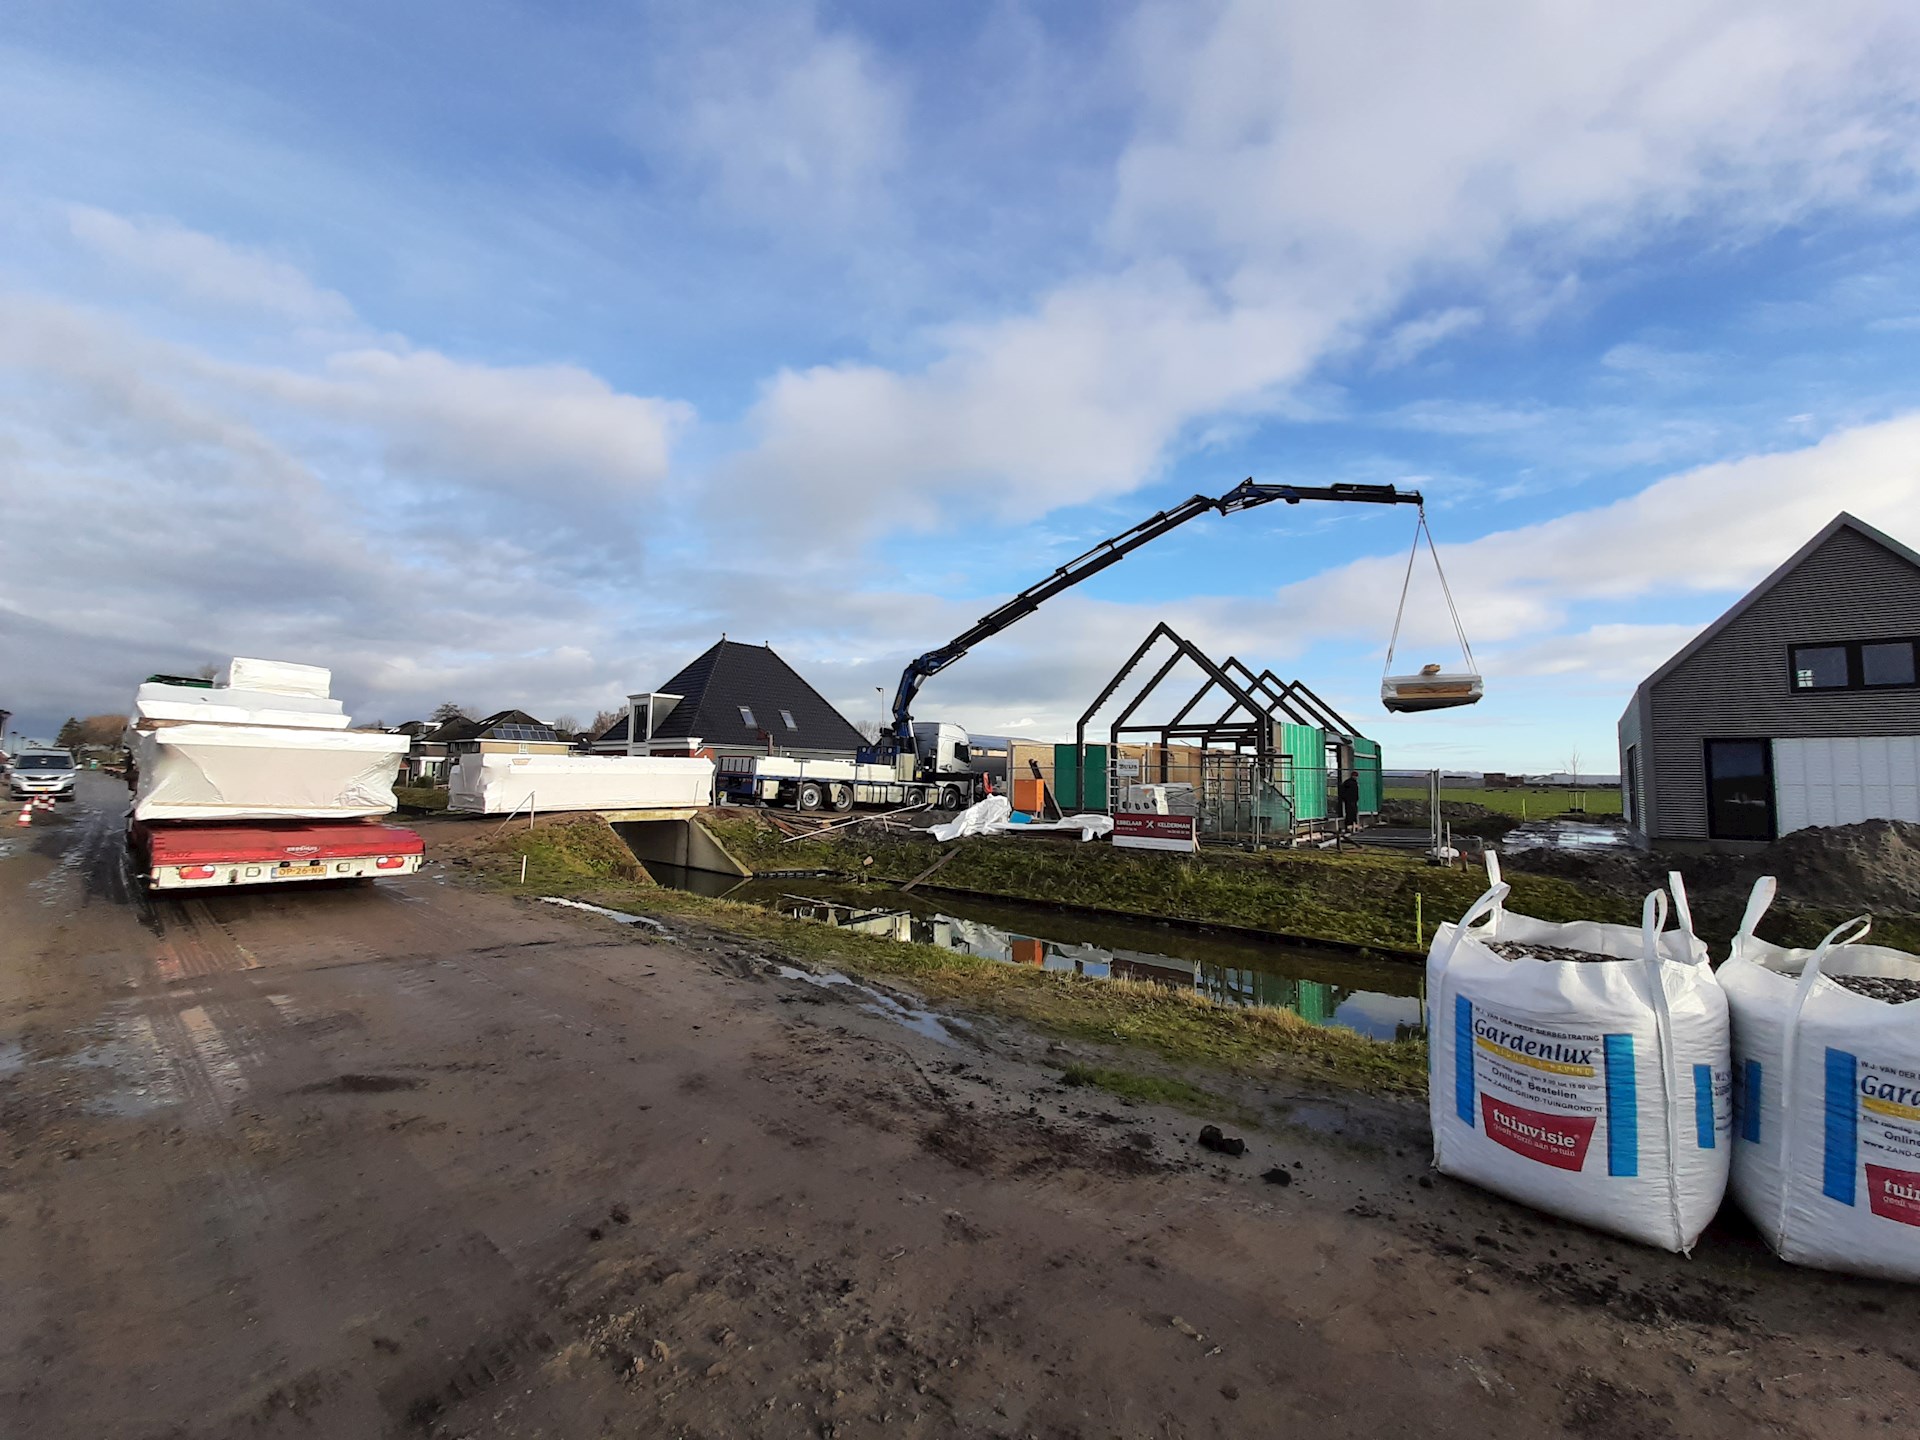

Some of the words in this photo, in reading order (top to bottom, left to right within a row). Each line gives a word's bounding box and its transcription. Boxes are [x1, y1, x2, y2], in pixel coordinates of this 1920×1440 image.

[279, 867, 325, 875] OP-26-NR
[1487, 1012, 1499, 1020] VAN
[1500, 1017, 1513, 1026] DER
[1514, 1023, 1534, 1033] HEIDE
[1536, 1029, 1600, 1041] SIERBESTRATING
[1492, 1066, 1522, 1085] Online
[1528, 1082, 1577, 1099] Bestellen
[1879, 1066, 1896, 1075] VAN
[1898, 1070, 1916, 1079] DER
[1493, 1109, 1575, 1148] tuinvisie
[1513, 1133, 1533, 1145] vorm
[1534, 1141, 1549, 1150] aan
[1550, 1145, 1558, 1153] je
[1559, 1146, 1575, 1157] tuin
